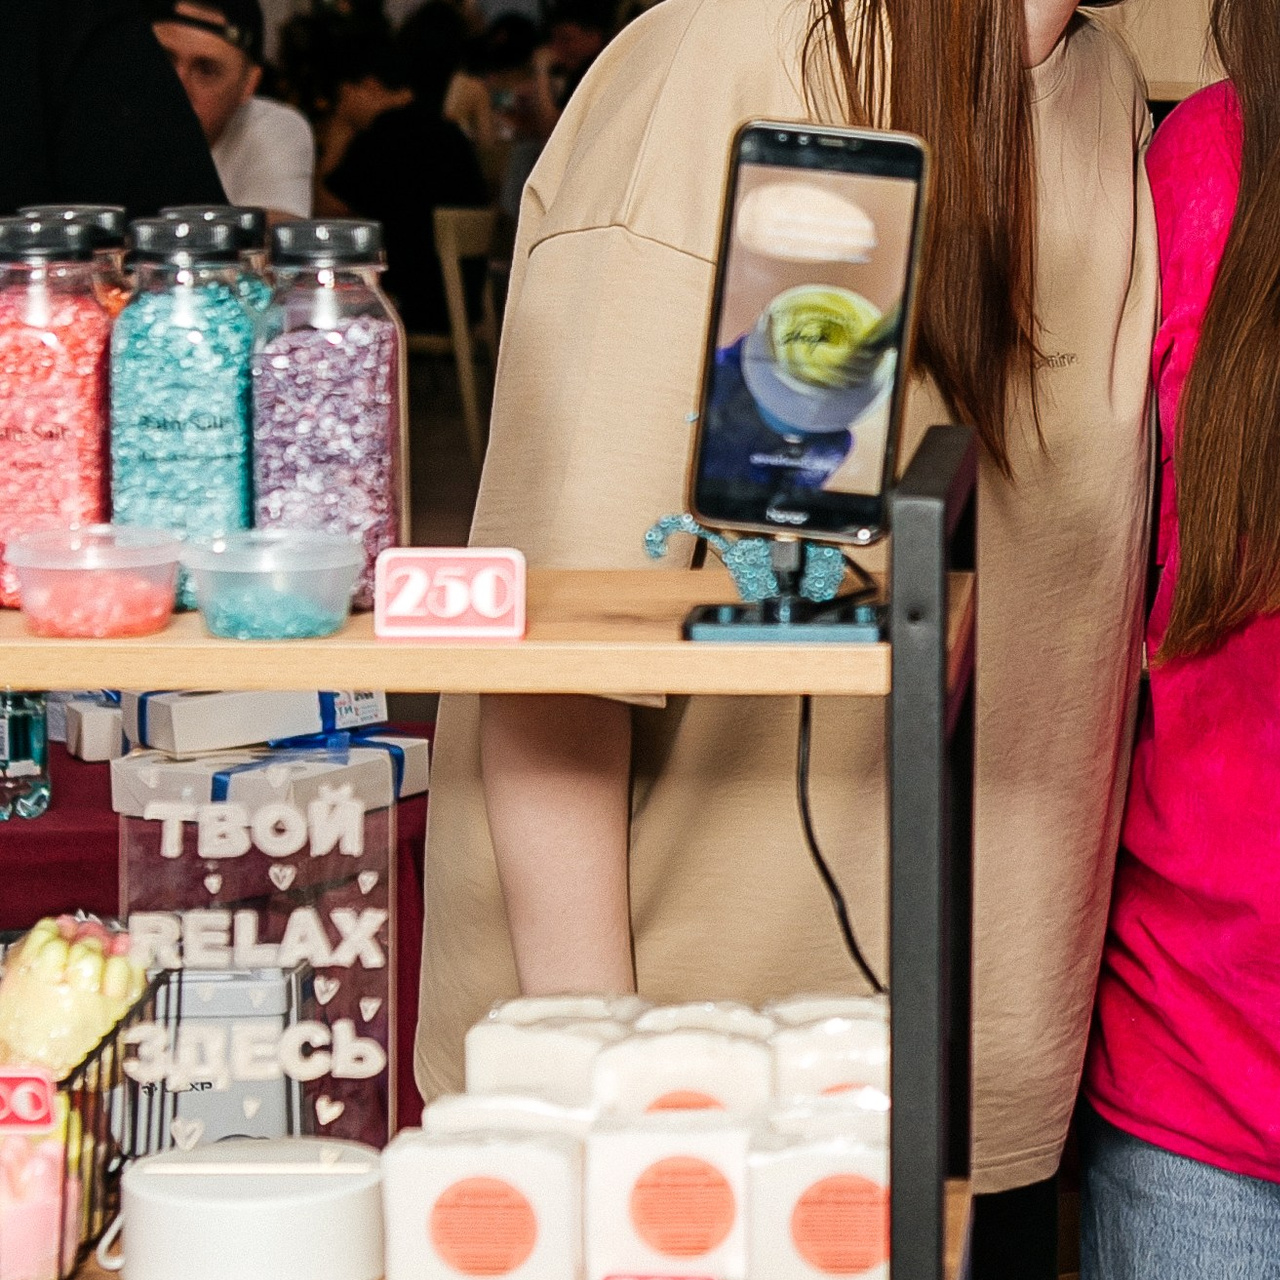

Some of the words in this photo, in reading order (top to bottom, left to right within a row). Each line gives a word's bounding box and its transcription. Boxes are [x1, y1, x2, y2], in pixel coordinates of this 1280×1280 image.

[385, 566, 516, 619] 250
[143, 783, 365, 858] ТВОЙ
[127, 906, 388, 969] RELAX
[123, 1019, 387, 1091] ЗДЕСЬ
